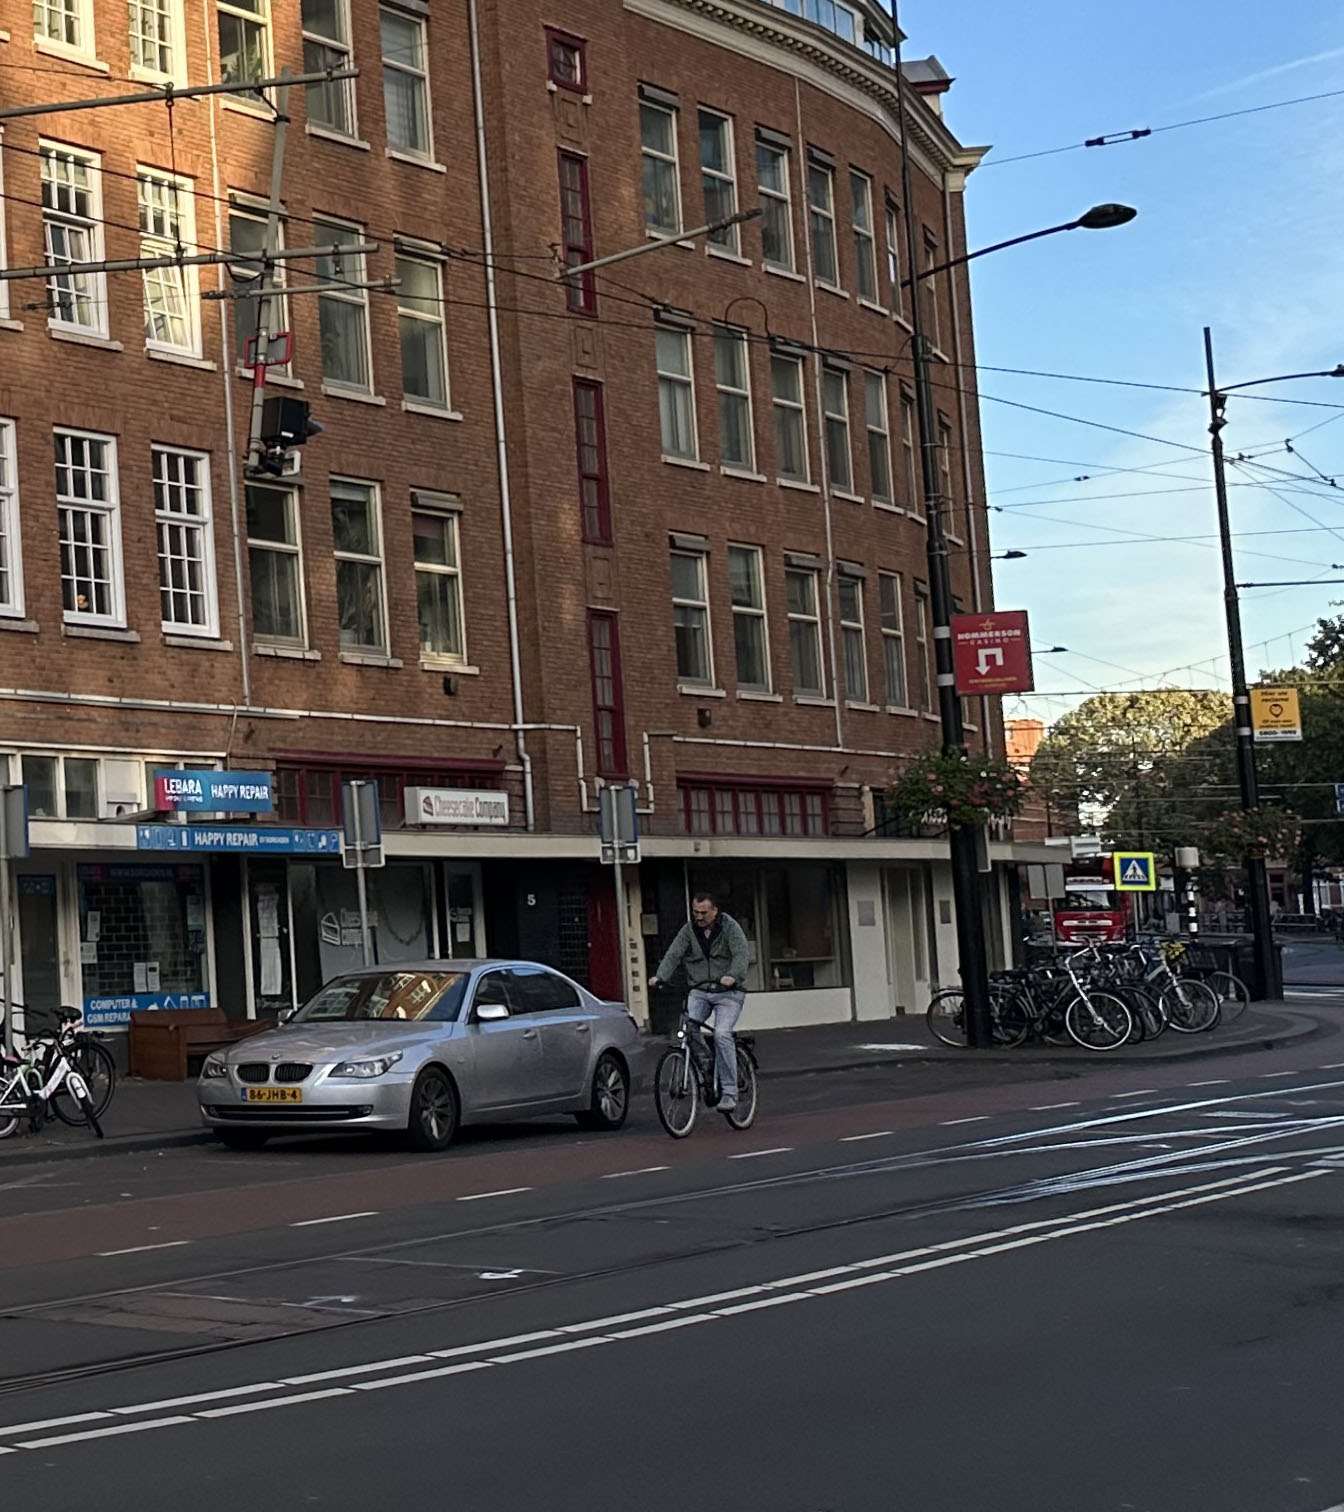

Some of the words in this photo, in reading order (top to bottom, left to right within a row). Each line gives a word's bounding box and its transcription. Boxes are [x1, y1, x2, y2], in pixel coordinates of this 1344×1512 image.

[957, 629, 1021, 640] HOMMERSON
[969, 638, 1009, 646] CASINO
[163, 778, 203, 795] LEBARA
[211, 784, 239, 800] HAPPY
[239, 784, 269, 800] REPAIR
[475, 796, 506, 824] Company
[194, 831, 226, 846] HAPPY
[226, 832, 259, 847] REPAIR
[90, 999, 131, 1010] COMPUTER
[87, 1013, 104, 1024] GSM
